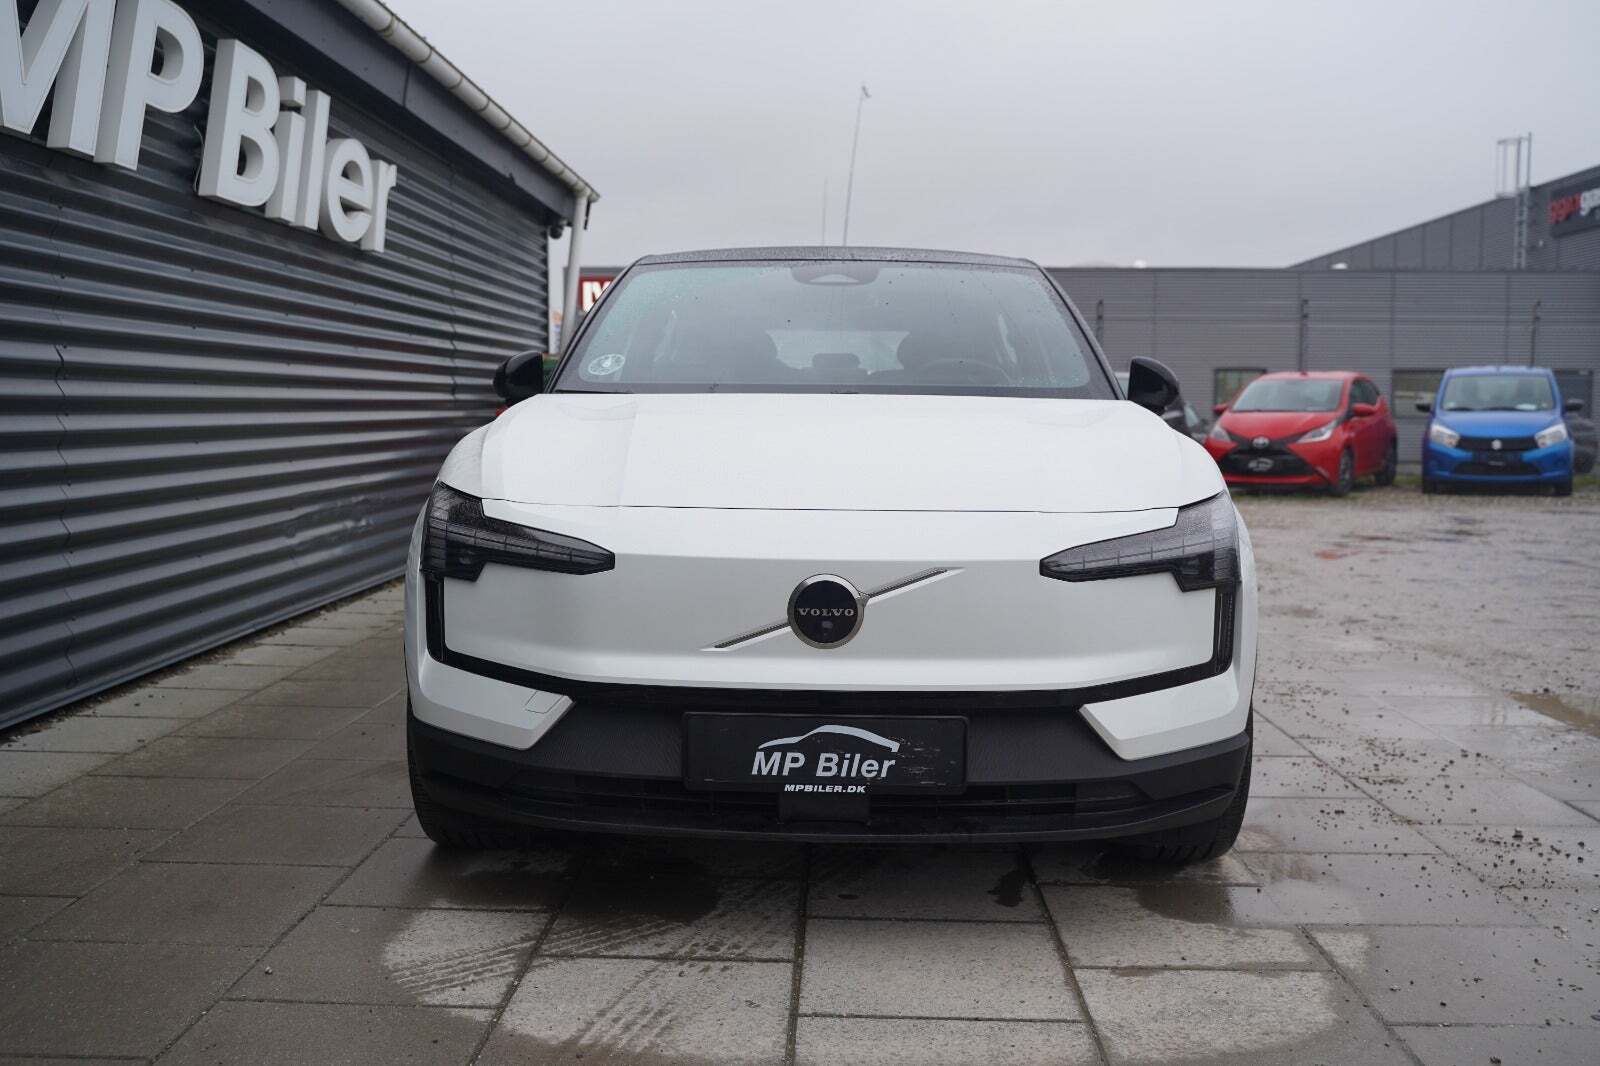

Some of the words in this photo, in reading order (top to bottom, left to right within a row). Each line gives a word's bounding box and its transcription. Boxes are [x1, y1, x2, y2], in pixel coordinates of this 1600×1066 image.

[0, 0, 204, 171] MP
[198, 39, 397, 252] Biler
[798, 607, 855, 616] VOLVO
[751, 751, 805, 776] MP
[815, 752, 896, 778] Biler
[784, 783, 866, 793] MPBILER.DK
